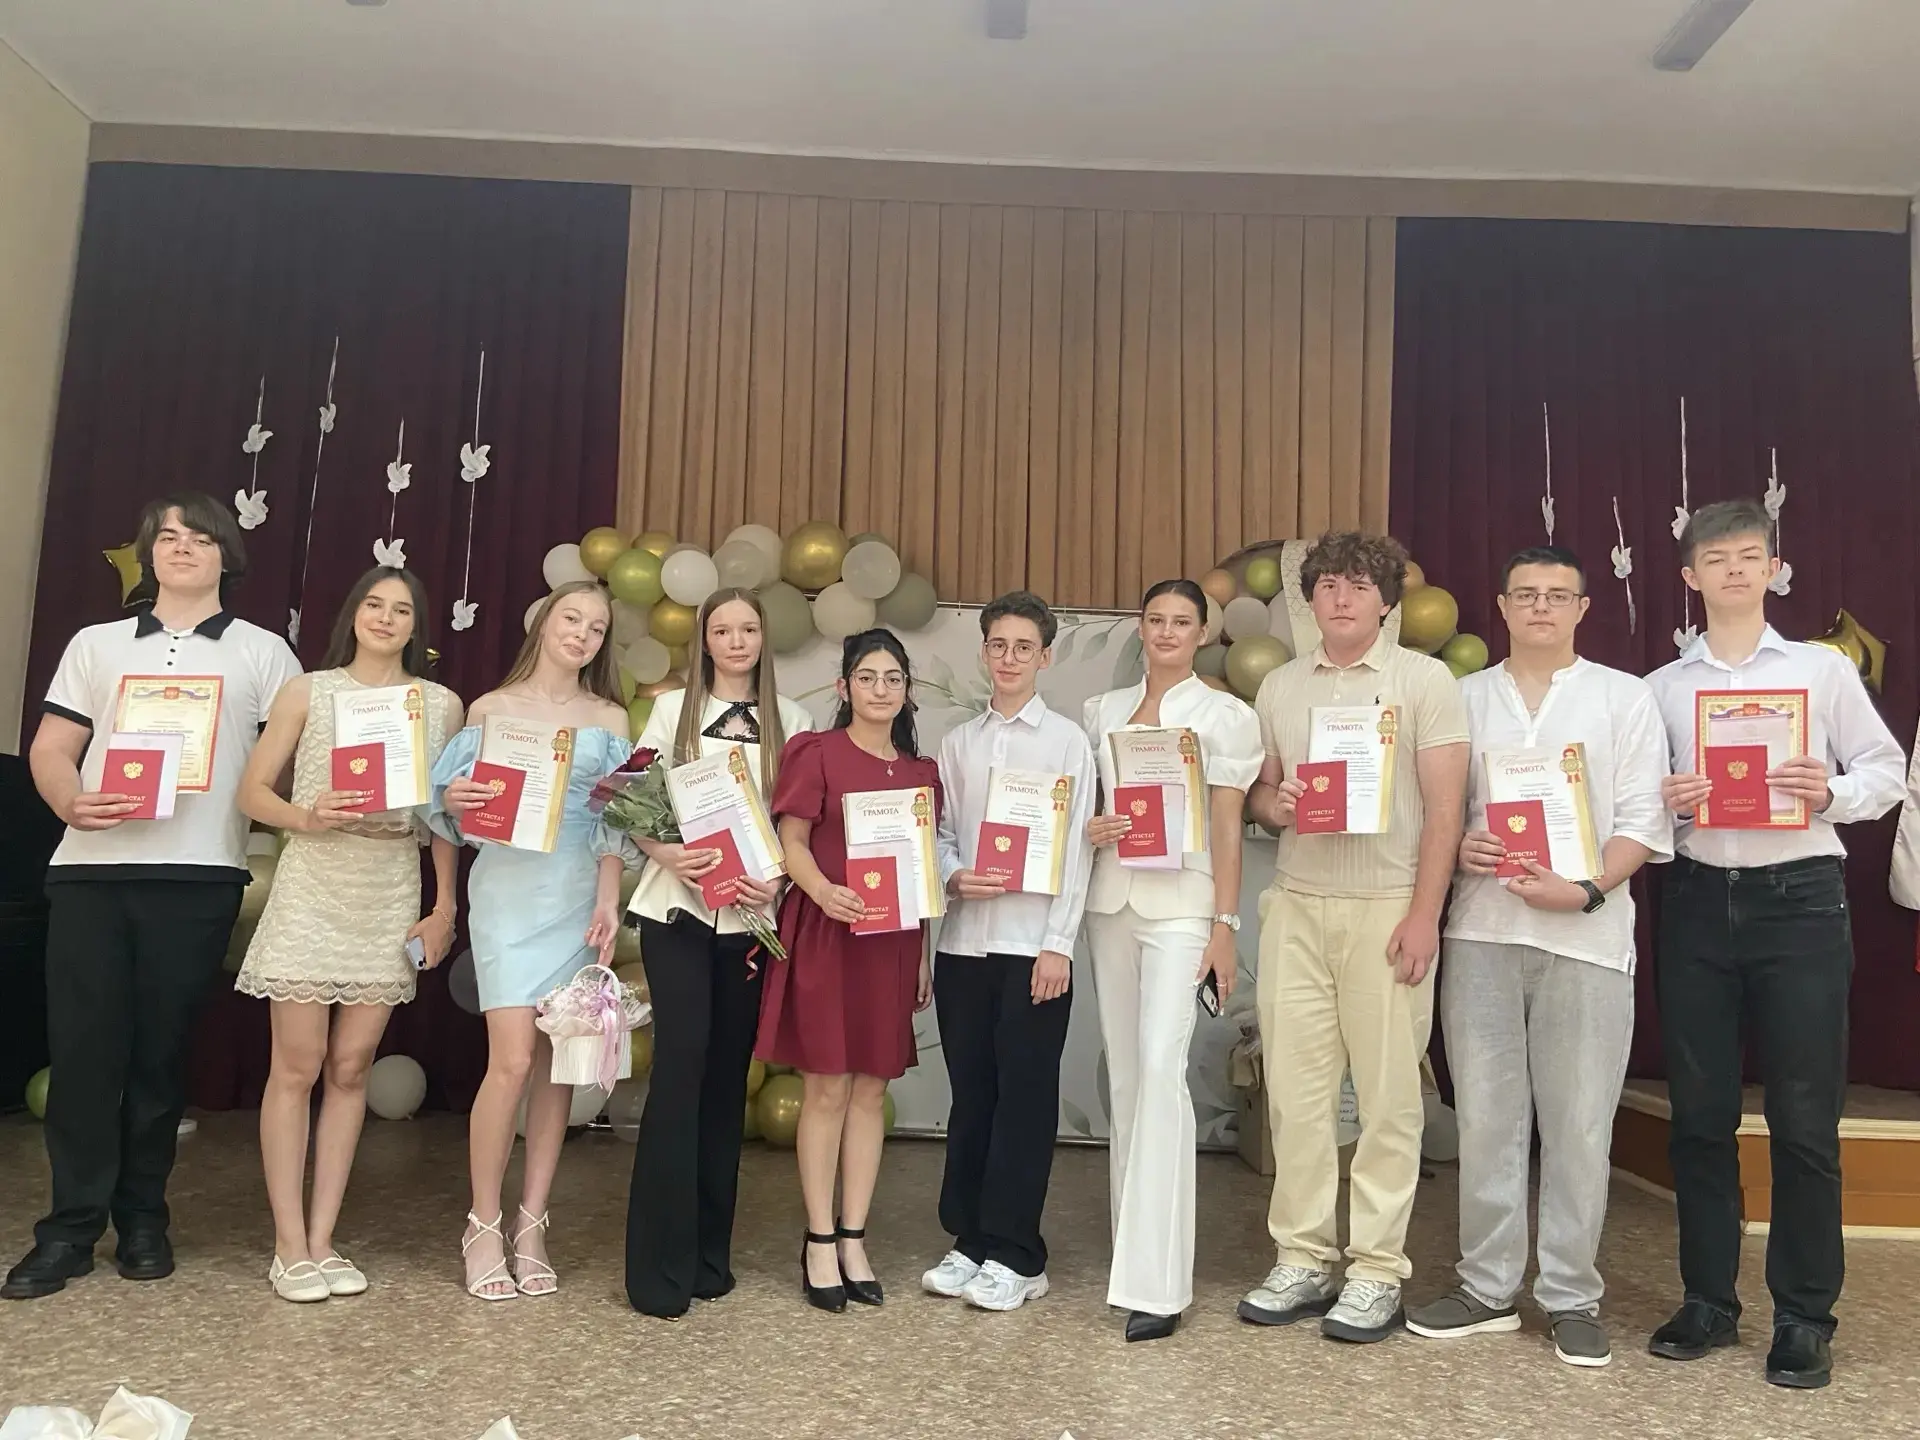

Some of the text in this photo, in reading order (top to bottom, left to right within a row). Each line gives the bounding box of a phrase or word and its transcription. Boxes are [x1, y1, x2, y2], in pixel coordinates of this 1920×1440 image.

[352, 705, 390, 715] ГРАМОТА
[1326, 723, 1364, 732] ГРАМОТА
[502, 733, 538, 744] ГРАМОТА
[1130, 745, 1167, 753] ГРАМОТА
[1504, 765, 1546, 775] ГРАМОТА
[684, 771, 718, 789] ГРАМОТА
[1004, 785, 1039, 796] ГРАМОТА
[476, 812, 505, 821] АТТЕСТАТ
[863, 807, 900, 817] ГРАМОТА
[1506, 850, 1538, 858] АТТЕСТАТ
[985, 867, 1014, 875] АТТЕСТАТ
[713, 877, 738, 890] АТТЕСТАТ
